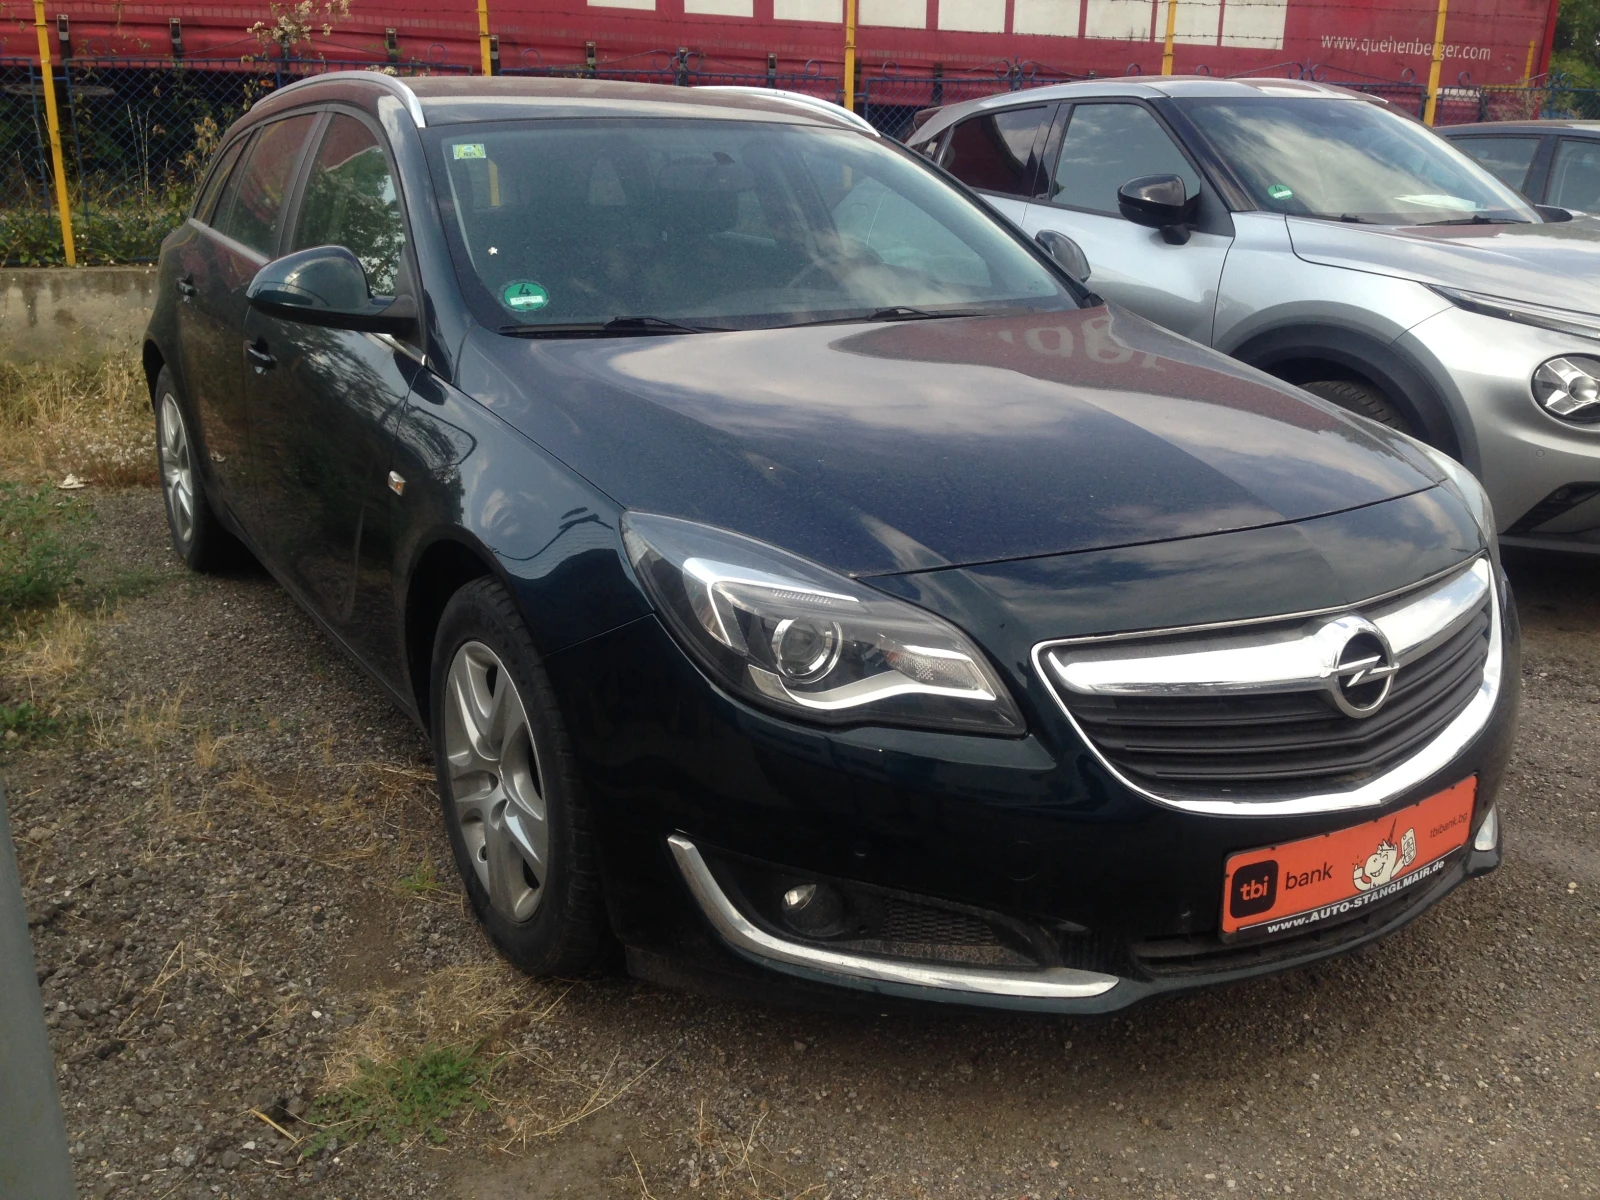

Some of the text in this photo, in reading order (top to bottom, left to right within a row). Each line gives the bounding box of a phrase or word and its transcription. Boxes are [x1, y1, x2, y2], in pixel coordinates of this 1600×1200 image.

[518, 283, 532, 296] 4
[1430, 812, 1468, 838] tbibank.bg
[1240, 861, 1333, 901] tbi bank
[1267, 860, 1445, 934] www.AUTO-STANGLMAIR.de
